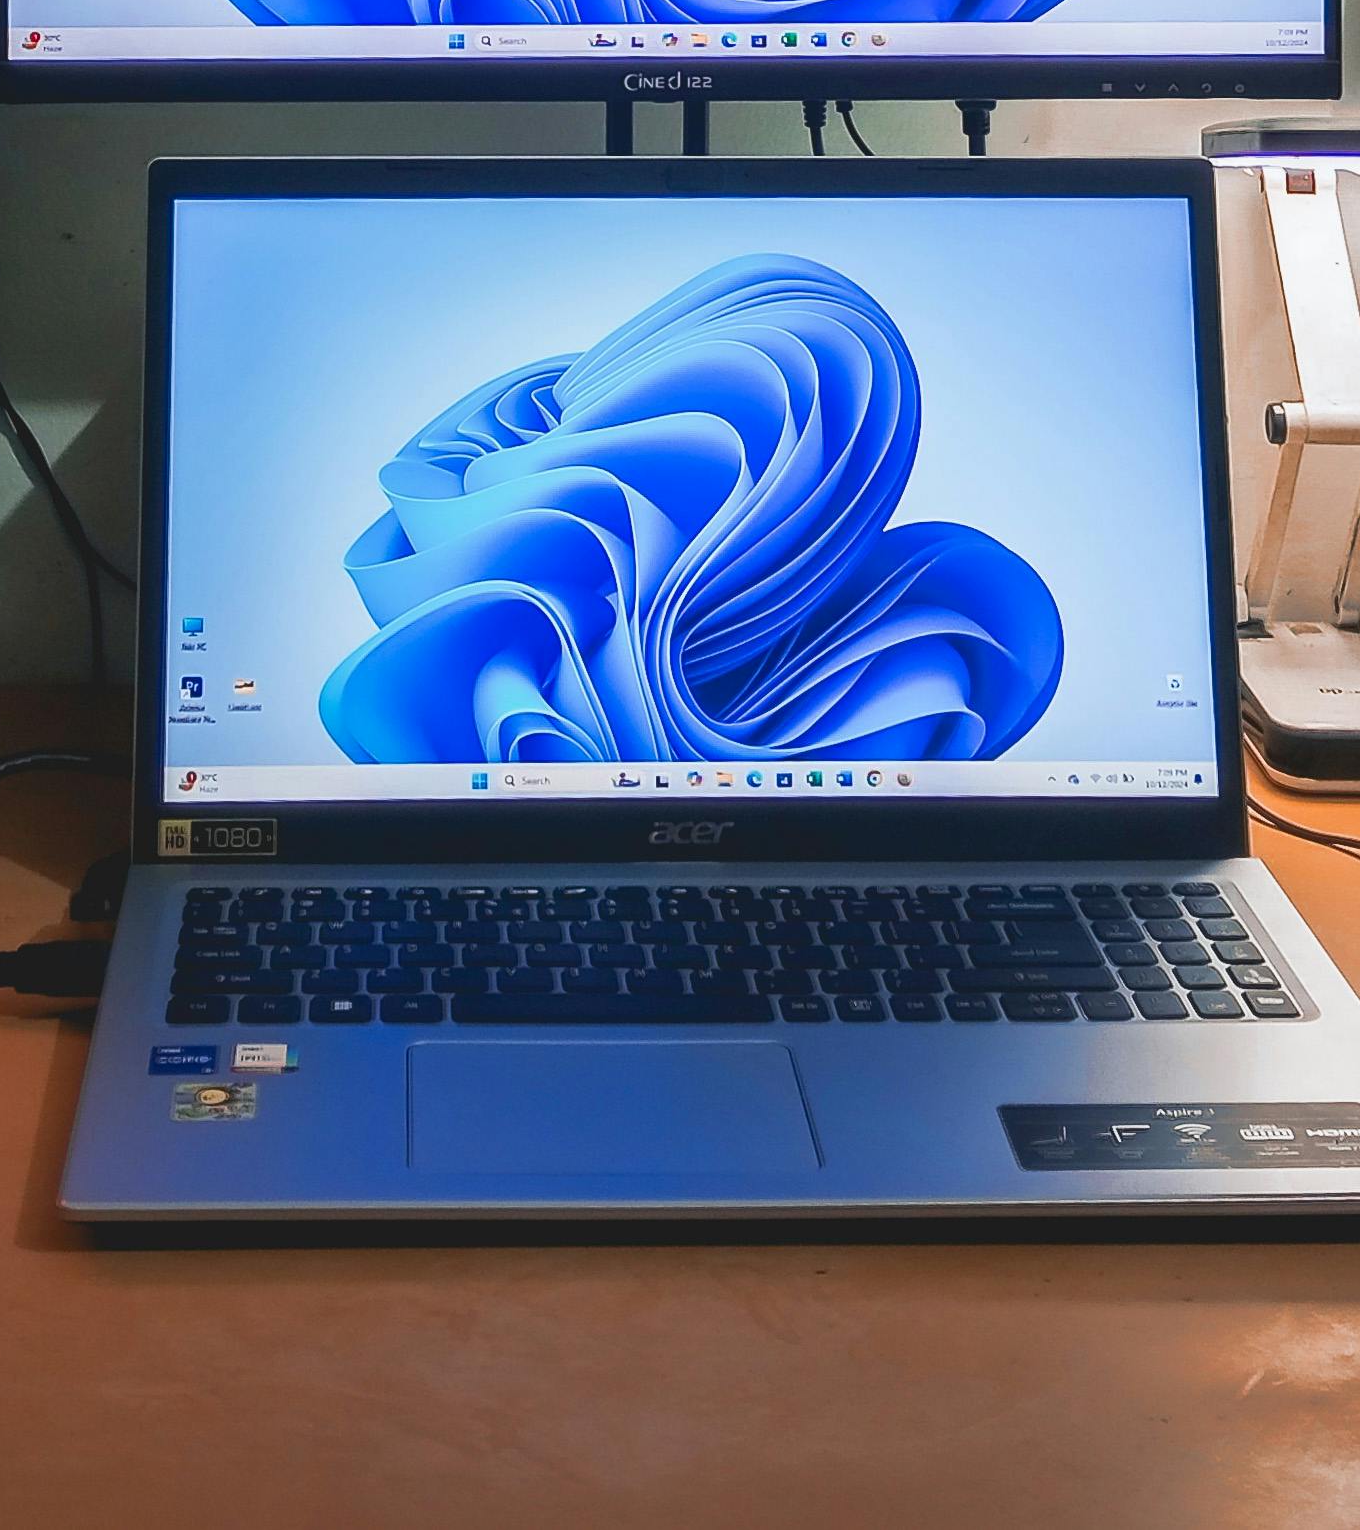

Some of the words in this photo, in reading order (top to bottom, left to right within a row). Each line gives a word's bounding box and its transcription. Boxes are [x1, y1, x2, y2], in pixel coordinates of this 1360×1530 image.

[204, 827, 262, 848] 1080
[648, 820, 735, 845] acer
[165, 835, 186, 850] HD
[1155, 1107, 1203, 1119] Aspire
